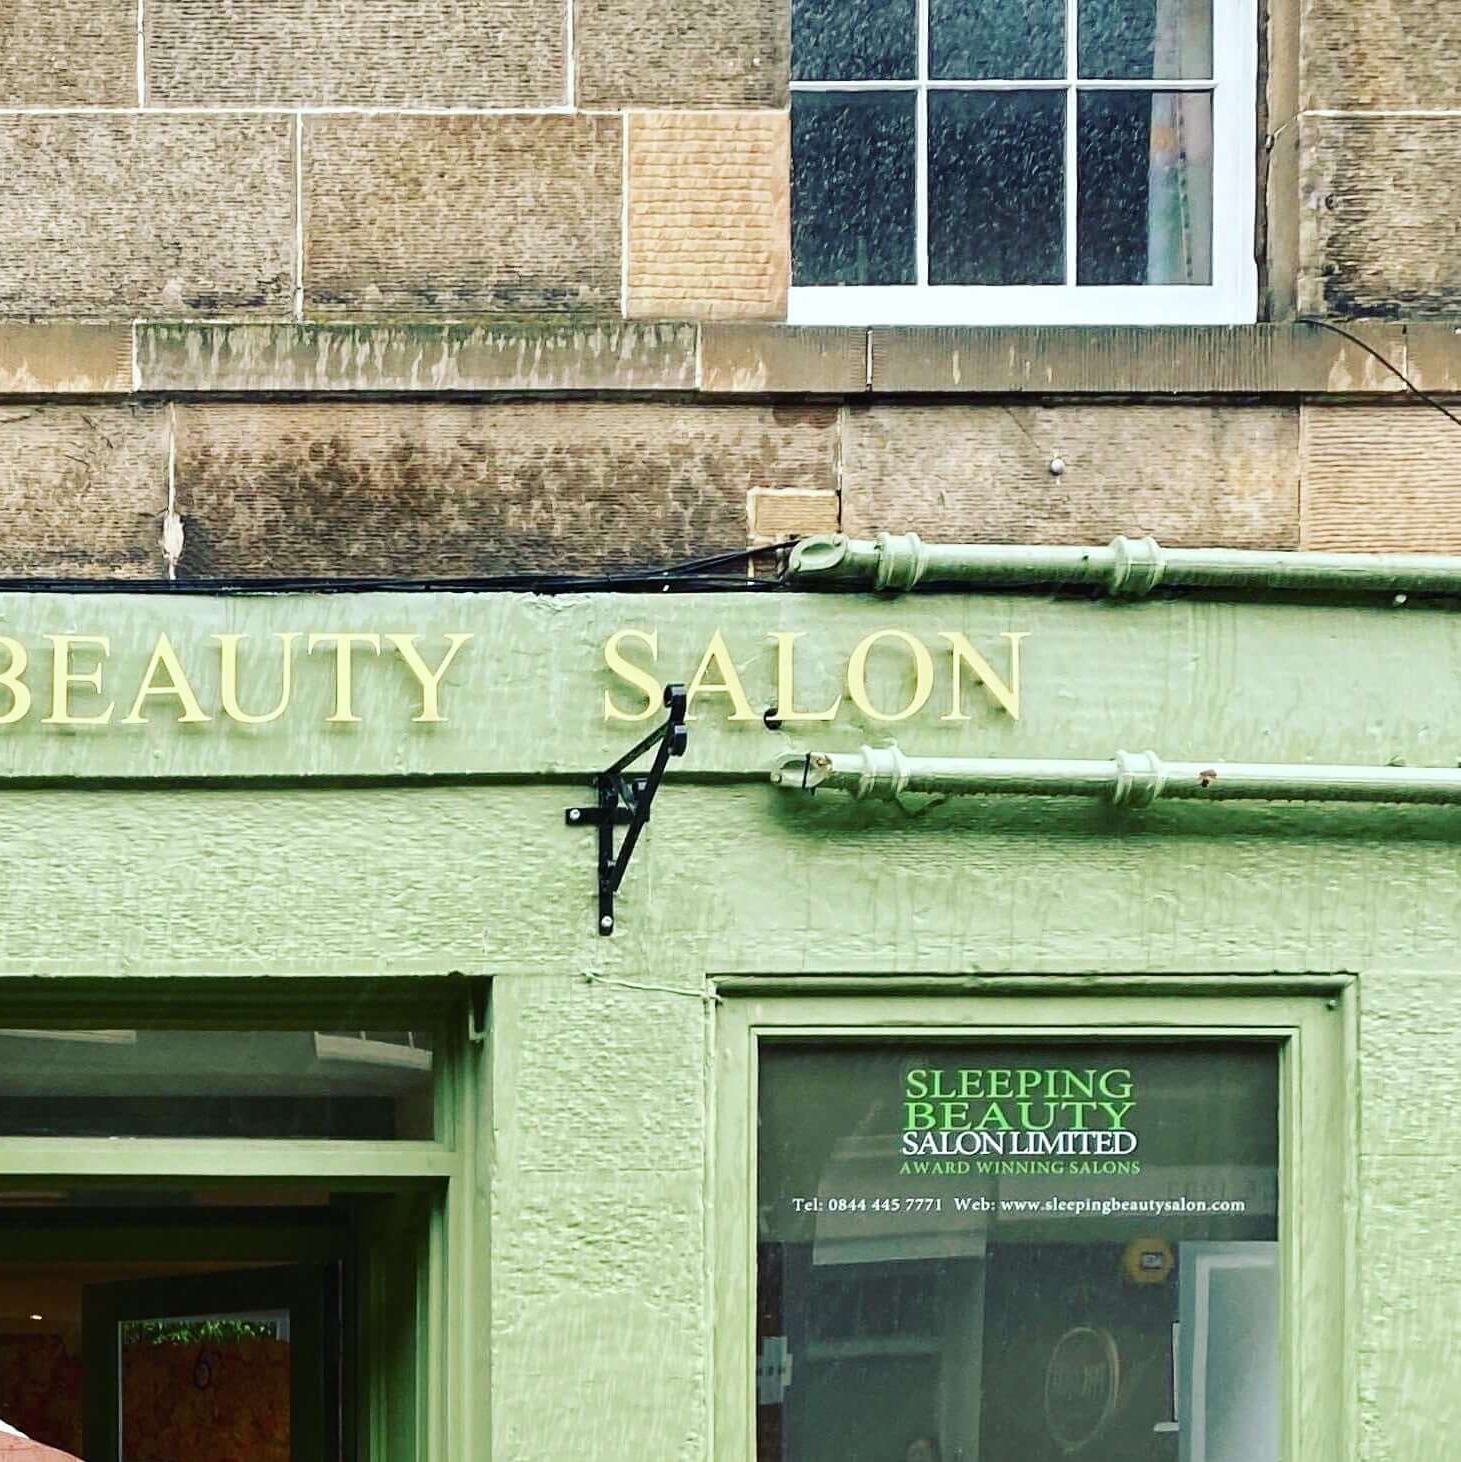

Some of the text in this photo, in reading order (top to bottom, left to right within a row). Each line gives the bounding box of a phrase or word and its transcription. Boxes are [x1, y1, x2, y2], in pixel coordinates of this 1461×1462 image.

[604, 628, 1031, 722] SALON
[905, 1069, 1134, 1099] SLEEPING
[903, 1101, 1137, 1131] BEAUTY
[899, 1160, 1140, 1175] AWARD WINNING SALONS
[792, 1198, 1246, 1215] Tel: 0844 445 7771 Web: www.sleepingbeautysalon.com
